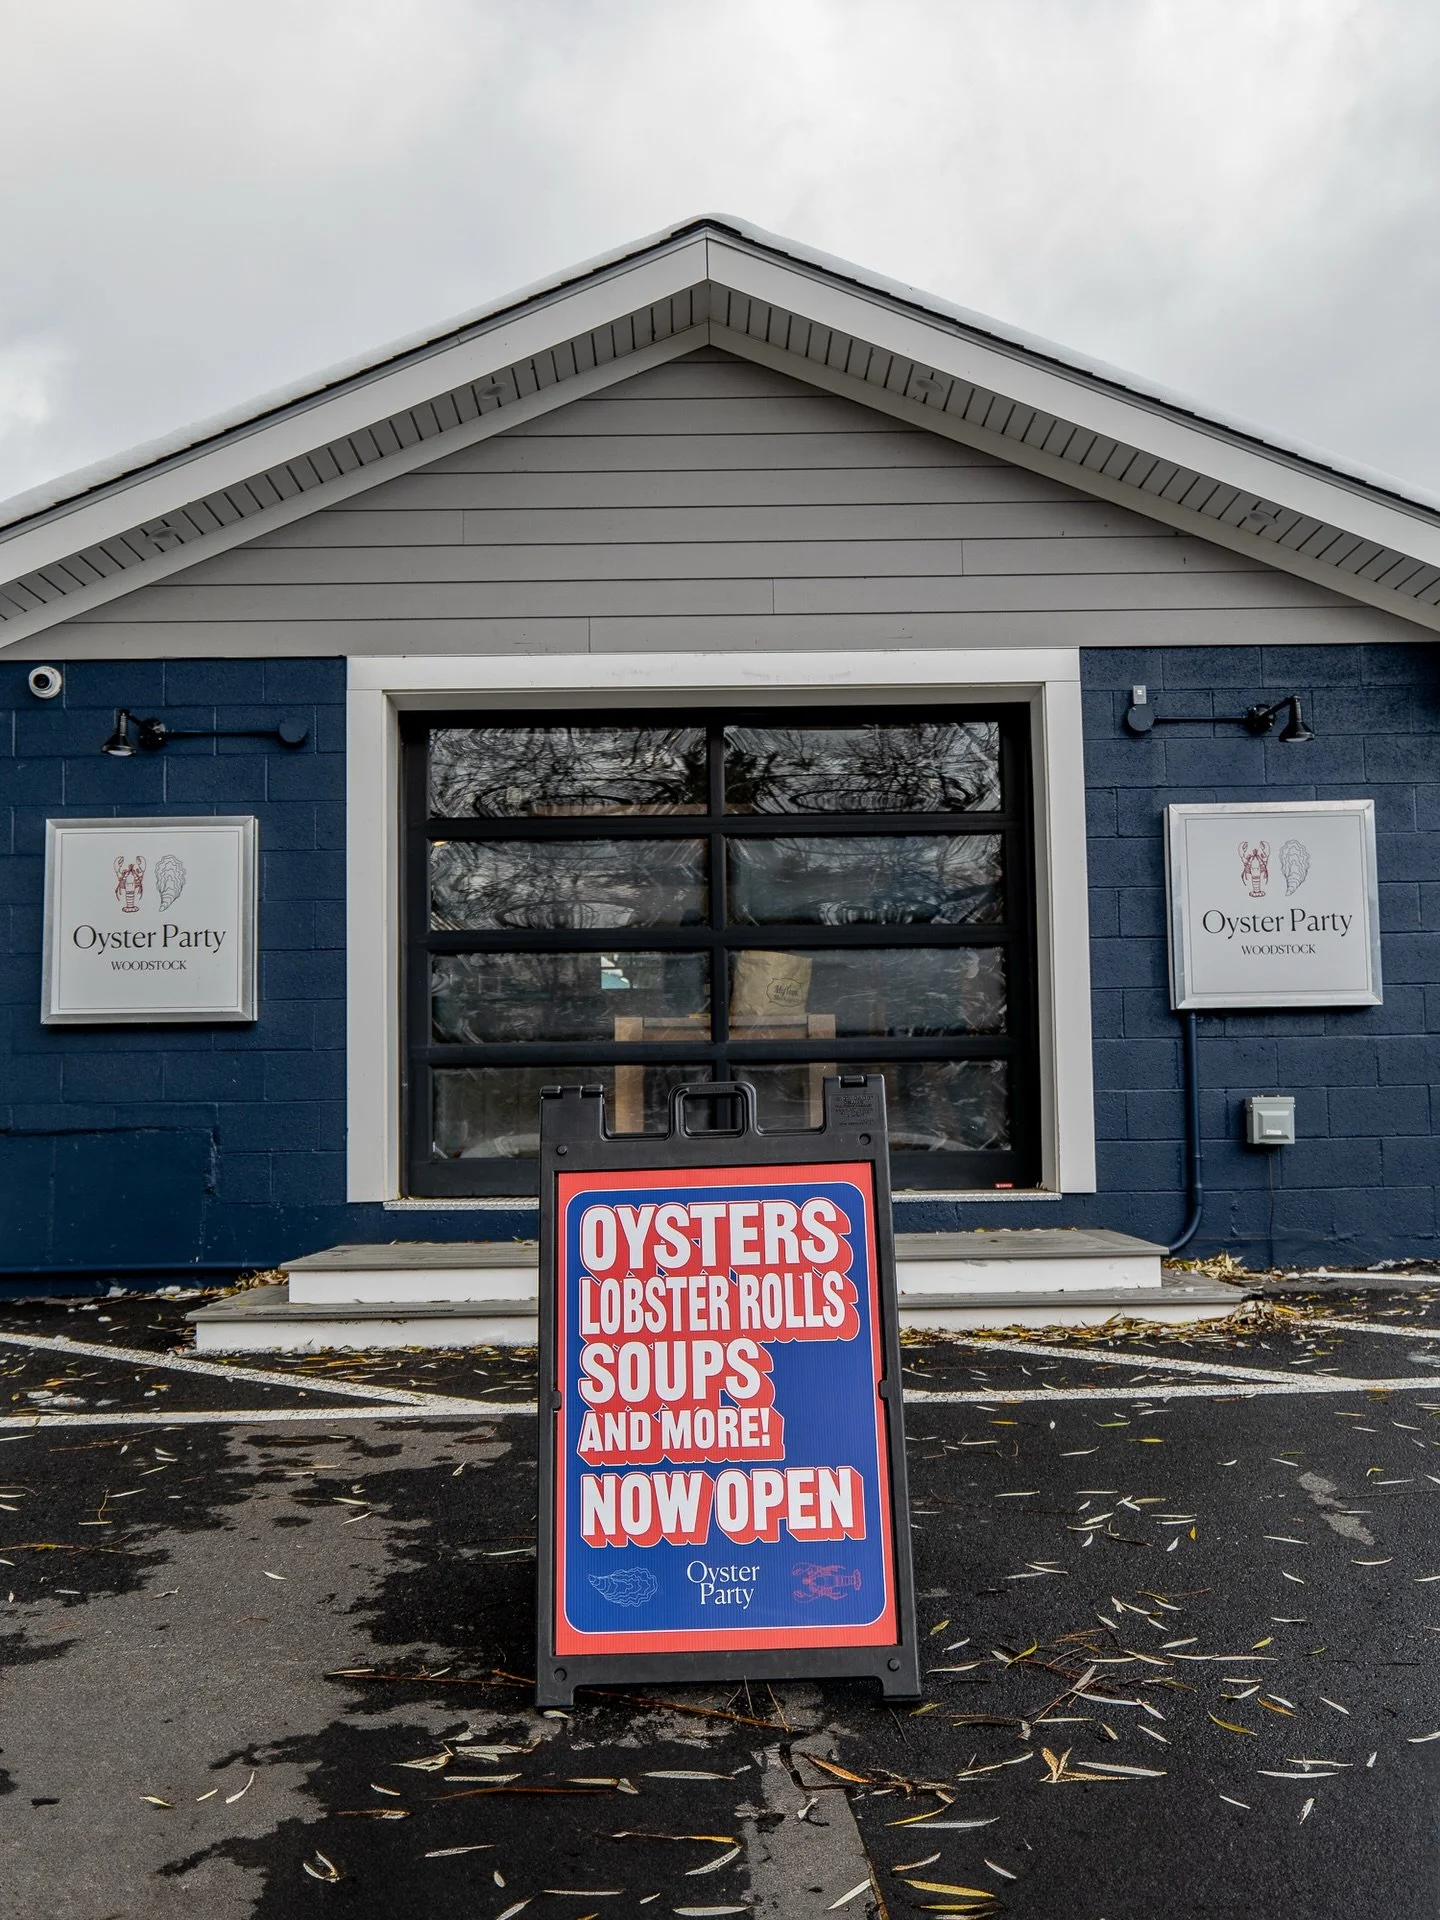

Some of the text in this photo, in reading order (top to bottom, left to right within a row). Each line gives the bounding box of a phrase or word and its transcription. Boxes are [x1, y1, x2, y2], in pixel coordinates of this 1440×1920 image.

[72, 923, 227, 955] Oyster Party
[1202, 908, 1353, 940] Oyster Party
[110, 959, 188, 972] WOODSTOCK
[1240, 944, 1317, 956] WOODSTOCK
[579, 1199, 840, 1270] OYSTERS
[580, 1270, 847, 1335] LOBSTER ROLLS
[580, 1337, 763, 1405] SOUPS
[579, 1407, 772, 1453] AND MORE!
[581, 1467, 854, 1538] NOW OPEN
[686, 1560, 761, 1588] Oyster
[698, 1581, 756, 1611] Party
